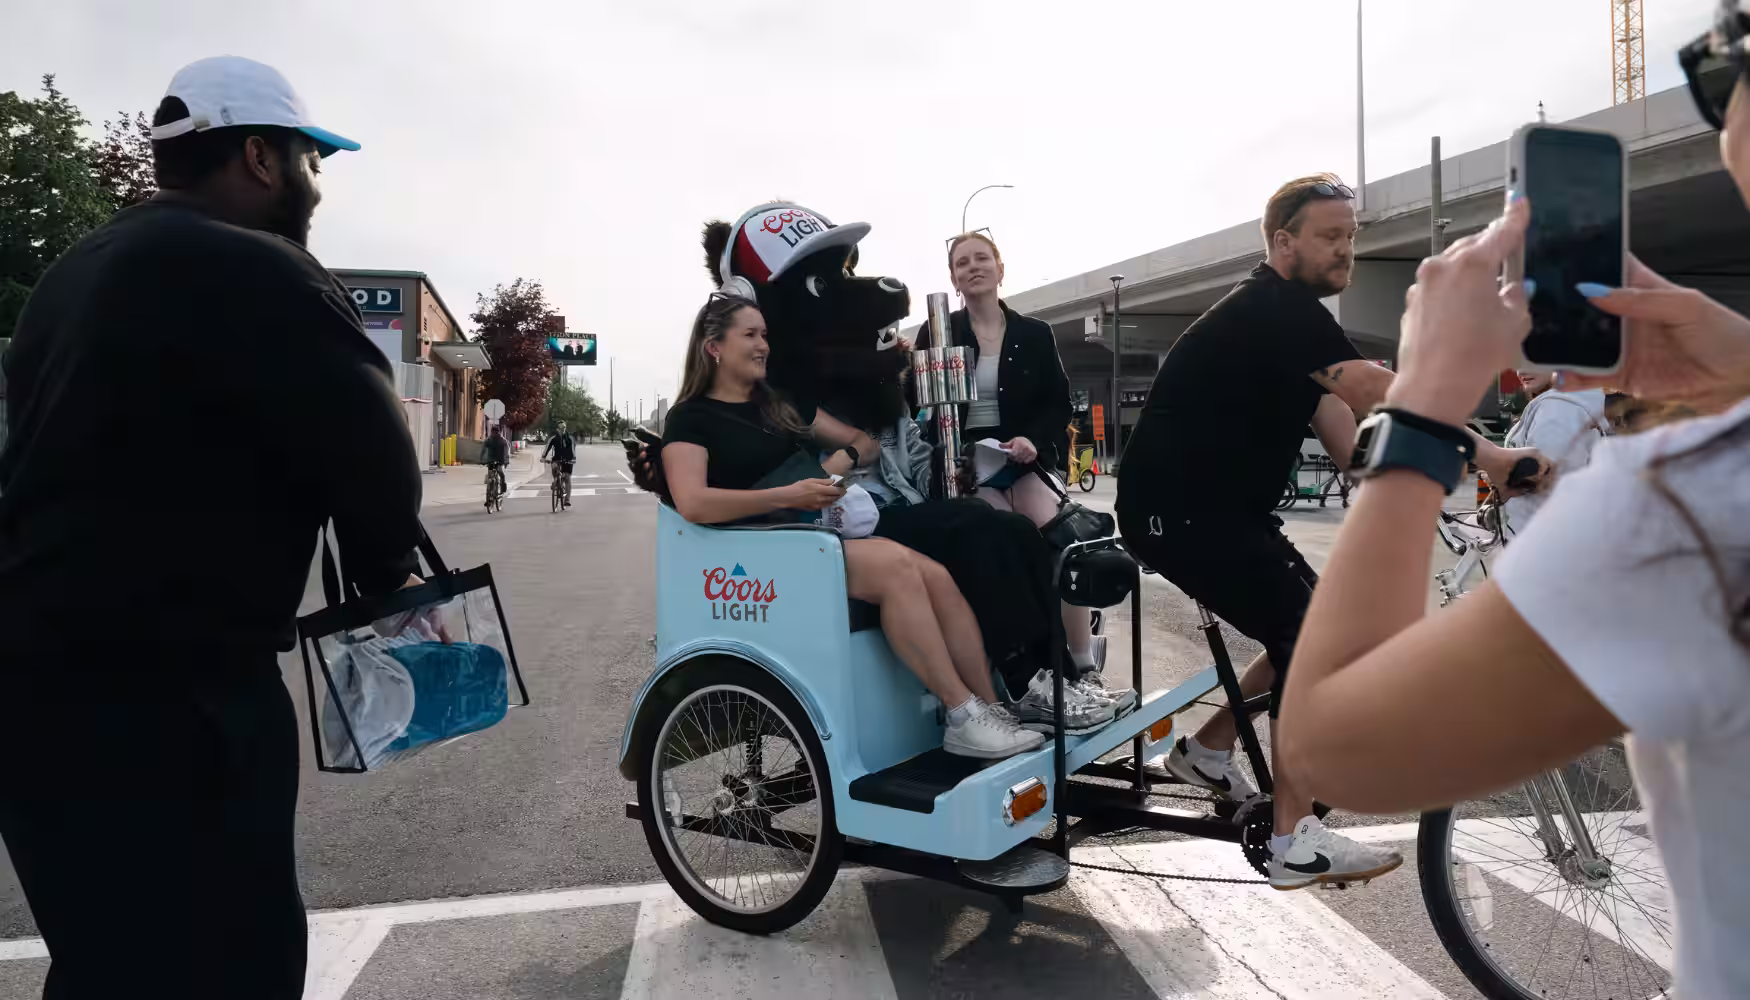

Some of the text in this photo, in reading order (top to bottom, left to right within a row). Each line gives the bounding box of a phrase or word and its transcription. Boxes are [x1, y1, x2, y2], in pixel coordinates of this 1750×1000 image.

[779, 218, 824, 249] LIGH
[702, 566, 778, 603] Coors
[711, 601, 770, 623] LIGHT
